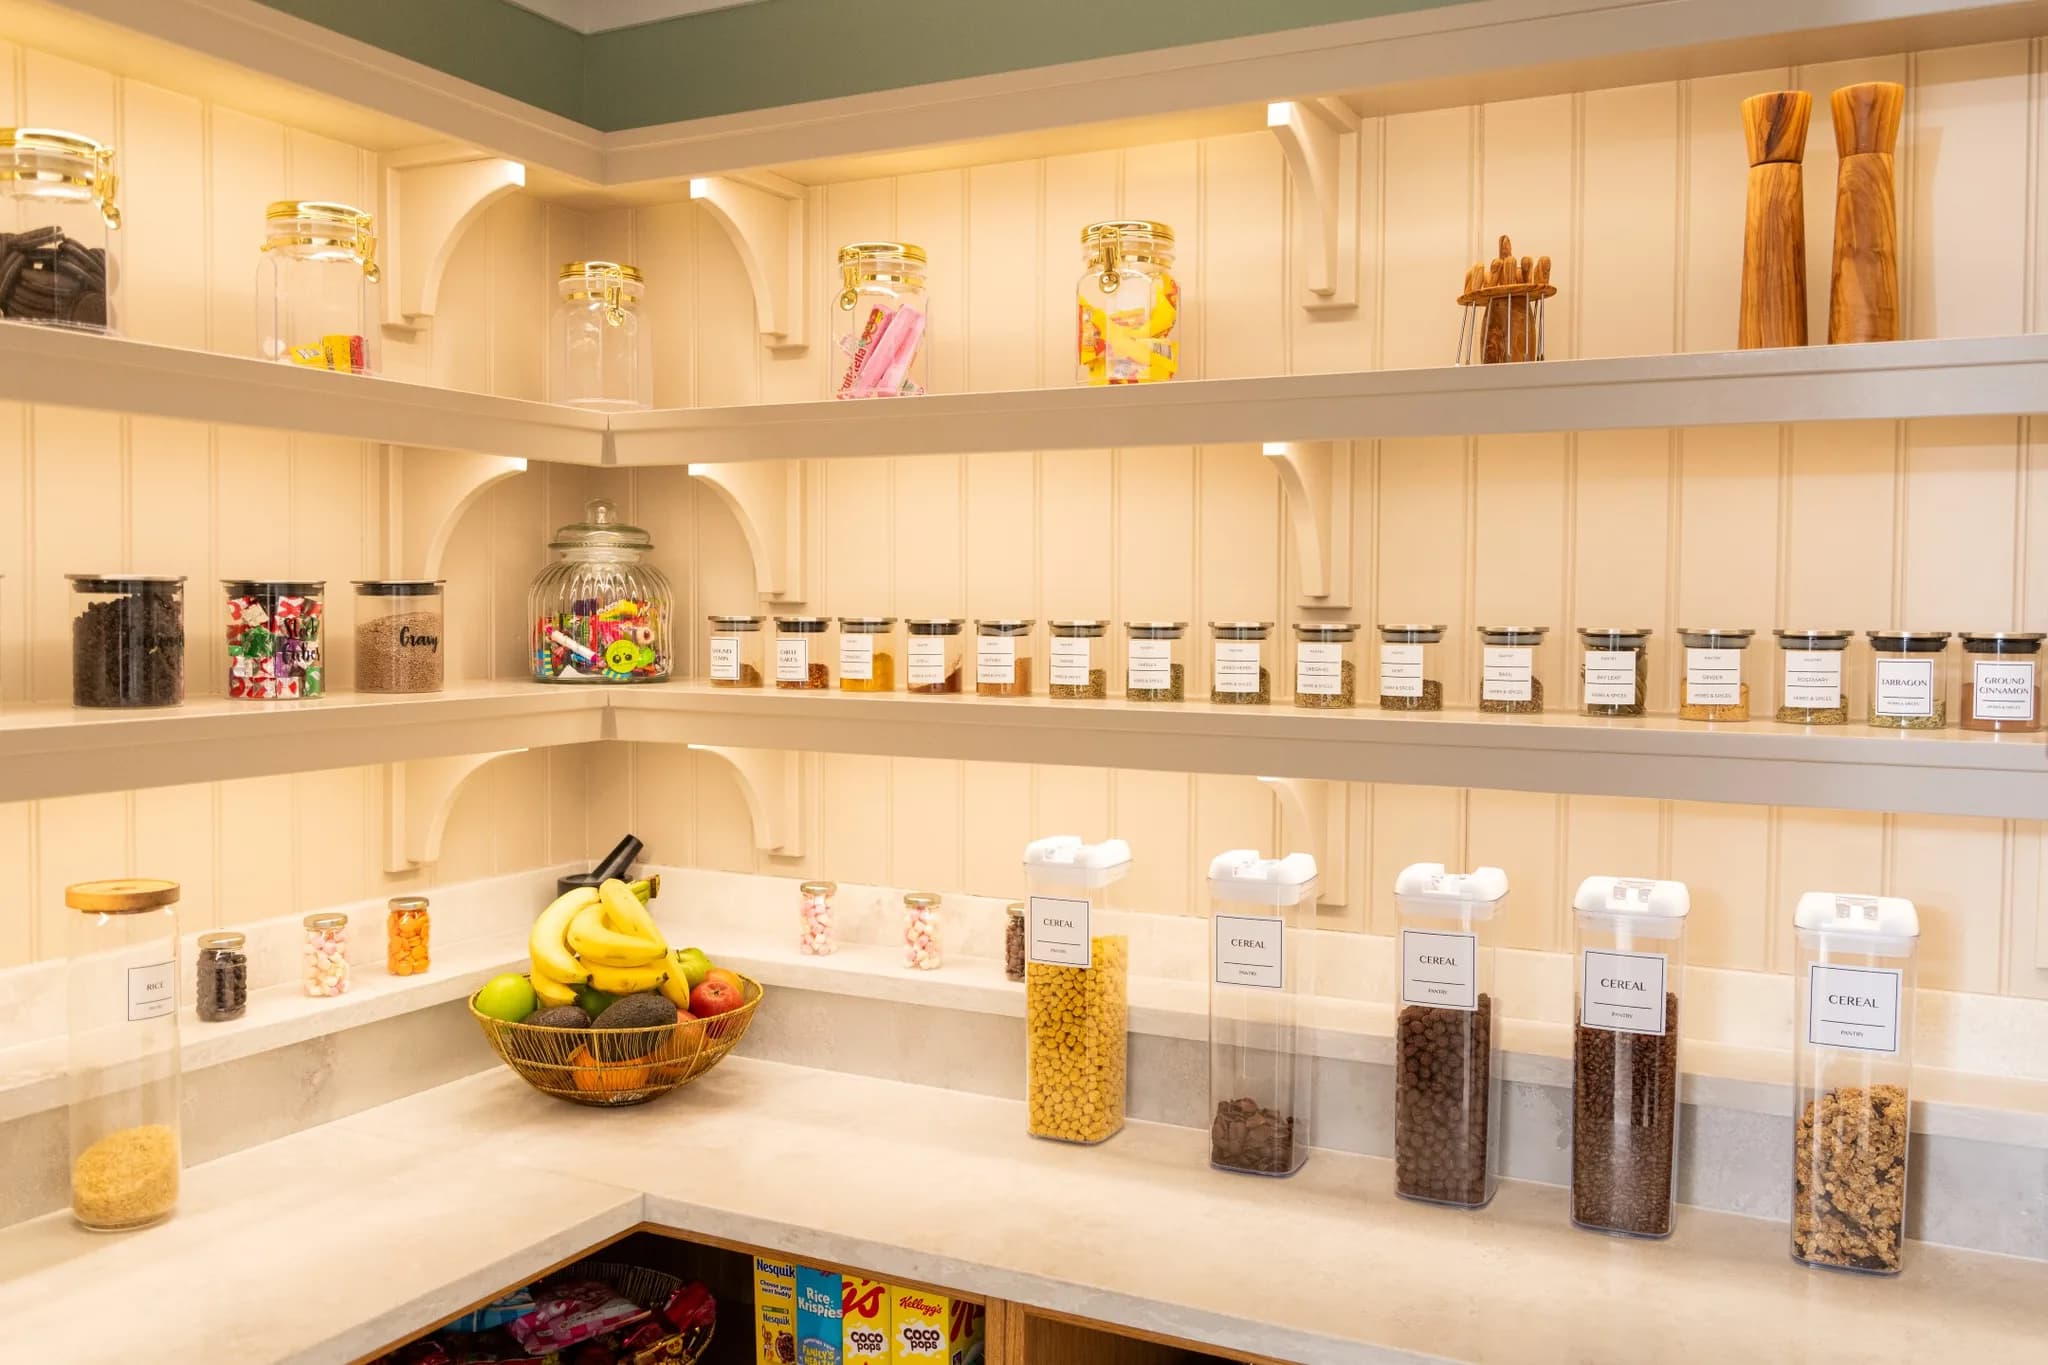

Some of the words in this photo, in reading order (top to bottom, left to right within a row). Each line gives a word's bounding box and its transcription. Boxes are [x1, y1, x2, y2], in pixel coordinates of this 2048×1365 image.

[400, 626, 438, 653] Gravy
[1882, 678, 1927, 687] TARRAGON
[1984, 676, 2025, 685] GROUND
[1979, 686, 2029, 695] CINNAMON
[1044, 918, 1075, 928] CEREAL
[1231, 938, 1266, 949] CEREAL
[1419, 955, 1458, 967] CEREAL
[146, 981, 164, 991] RICE
[1600, 978, 1647, 991] CEREAL
[1828, 994, 1879, 1008] CEREAL
[1840, 1030, 1864, 1038] PANTRY
[756, 1258, 795, 1279] Nesquik
[760, 1280, 779, 1289] Choose
[774, 1289, 791, 1299] buddy
[806, 1287, 830, 1304] Rice
[797, 1296, 843, 1318] Krispies
[899, 1296, 943, 1317] Kellogg's
[763, 1312, 790, 1326] Nesquik
[857, 1341, 881, 1353] pops
[910, 1340, 938, 1352] pops
